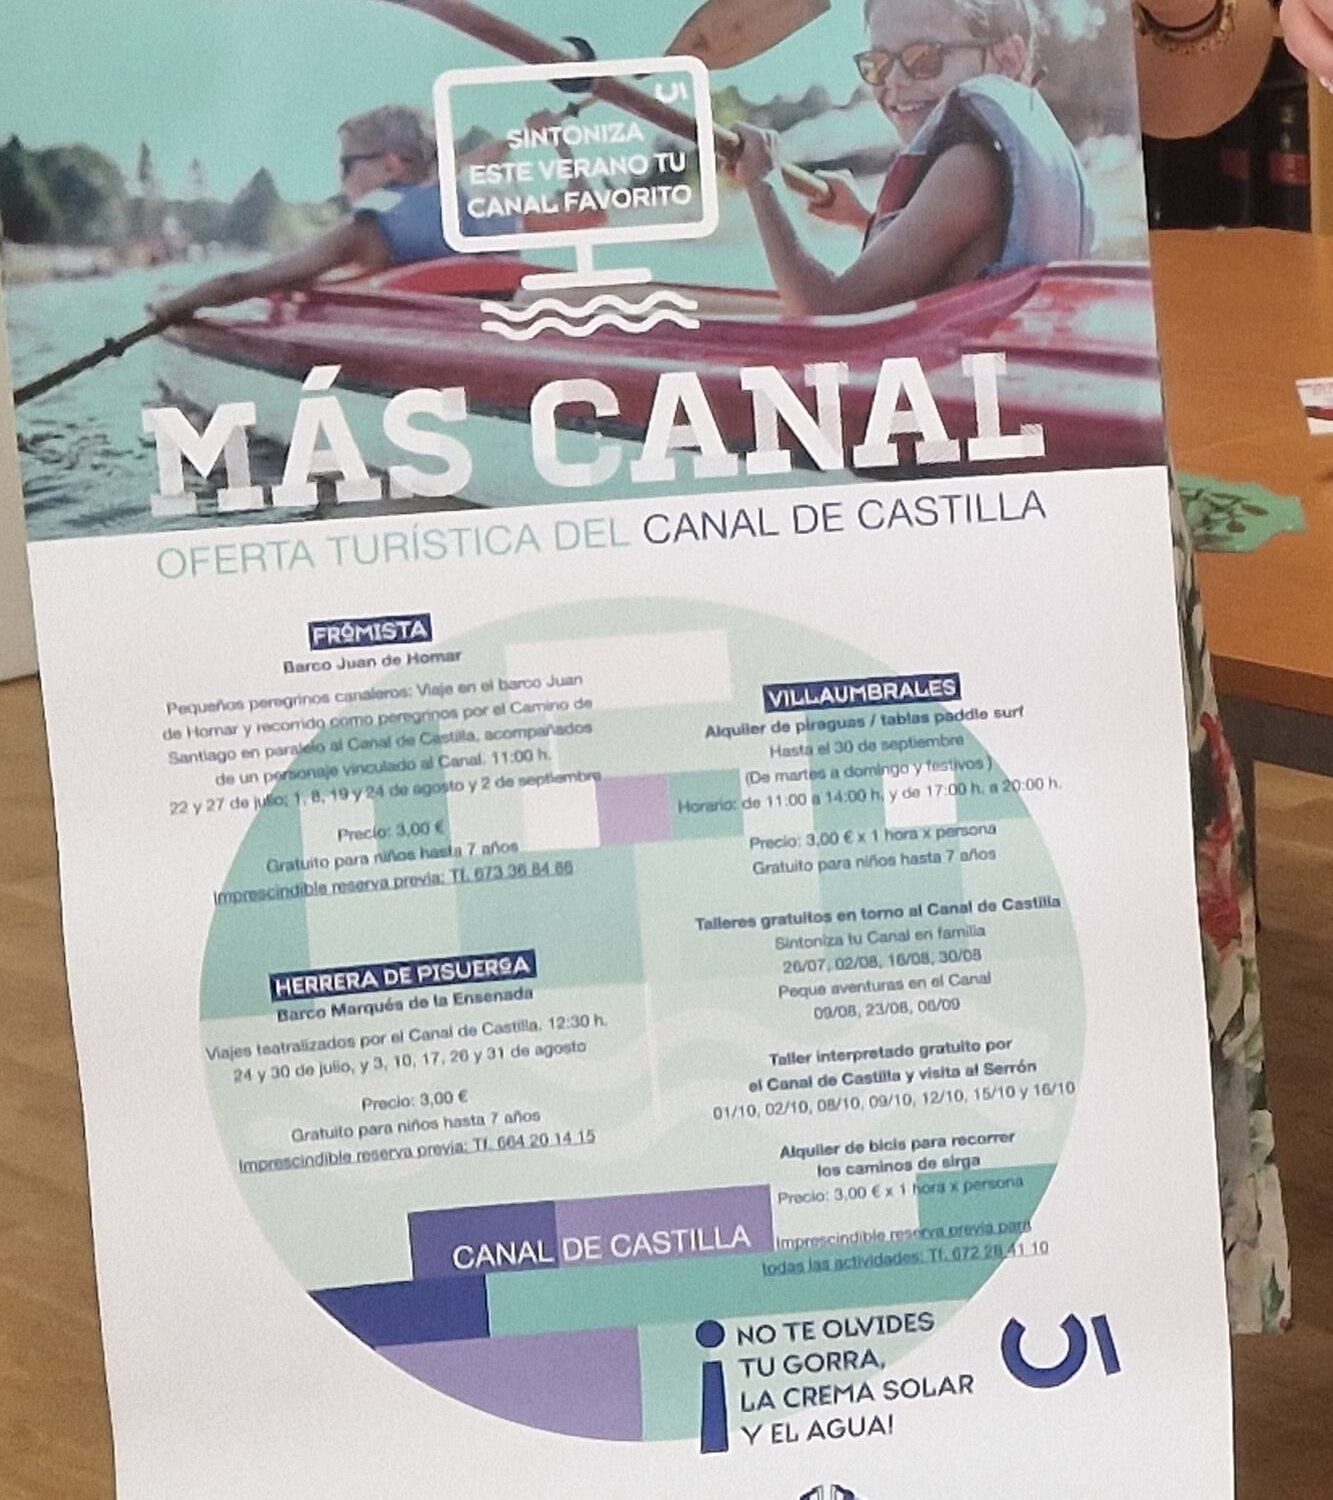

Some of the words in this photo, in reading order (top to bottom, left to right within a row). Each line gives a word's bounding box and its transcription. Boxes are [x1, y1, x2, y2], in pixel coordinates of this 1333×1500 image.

[507, 122, 644, 150] SINTONIZA
[470, 162, 533, 185] ESTE
[538, 155, 648, 181] VERANO
[655, 152, 686, 172] TU
[467, 196, 558, 219] CANAL
[565, 185, 692, 212] FAVORITO
[142, 364, 470, 516] MÁS
[530, 352, 1045, 489] CANAL
[157, 540, 314, 579] OFERTA
[327, 522, 540, 566] TURÍSTICA
[555, 518, 630, 549] DEL
[643, 507, 779, 544] CANAL
[793, 503, 844, 534] DE
[858, 490, 1046, 530] CASTILLA
[283, 655, 331, 672] Barco
[336, 652, 376, 670] Juan
[381, 651, 401, 667] de
[406, 648, 461, 666] Homar
[248, 689, 329, 712] peregrinos
[416, 680, 453, 700] Viaje
[458, 681, 476, 695] en
[480, 677, 493, 693] el
[498, 674, 541, 692] barco
[546, 671, 582, 688] Juan
[768, 678, 956, 709] VILLAUMBRALES
[705, 719, 766, 741] Alquiler
[770, 718, 790, 734] de
[795, 713, 864, 736] piraguas
[880, 709, 929, 727] tablas
[934, 705, 988, 727] paddle
[993, 703, 1023, 720] surf
[695, 911, 756, 930] Talleres
[760, 907, 832, 929] gratuitos
[836, 908, 856, 921] en
[860, 902, 903, 920] torno
[908, 901, 922, 917] al
[927, 898, 972, 916] Canal
[977, 897, 996, 913] de
[1002, 893, 1060, 912] Castilla
[275, 973, 378, 998] HERRERA
[384, 967, 413, 987] DE
[418, 957, 530, 983] PISUERGA
[277, 1002, 325, 1021] Barco
[330, 996, 403, 1020] Marqués
[408, 994, 428, 1010] de
[433, 992, 447, 1008] la
[452, 985, 532, 1006] Ensenada
[205, 1041, 251, 1063] Viajes
[256, 1033, 355, 1056] teatralizados
[360, 1034, 386, 1051] por
[391, 1029, 403, 1045] el
[408, 1025, 452, 1044] Canal
[457, 1024, 477, 1040] de
[549, 1015, 589, 1033] 12:30
[769, 1048, 811, 1065] Taller
[816, 1042, 913, 1065] interpretado
[919, 1038, 980, 1059] gratuito
[985, 1039, 1012, 1055] por
[780, 1139, 840, 1160] Alquiler
[845, 1137, 864, 1153] de
[869, 1135, 905, 1152] bicis
[911, 1135, 946, 1152] para
[951, 1131, 1014, 1147] recorrer
[453, 1240, 555, 1270] CANAL
[562, 1235, 602, 1261] DE
[610, 1224, 751, 1258] CASTILLA
[737, 1323, 777, 1346] NO
[783, 1320, 815, 1341] TE
[823, 1312, 935, 1339] OLVIDES
[738, 1357, 774, 1378] TU
[783, 1349, 886, 1374] GORRA,
[741, 1391, 775, 1413] LA
[783, 1382, 874, 1409] CREMA
[883, 1374, 974, 1401] SOLAR
[741, 1424, 762, 1446] Y
[771, 1423, 799, 1444] EL
[806, 1414, 894, 1441] AGUA!
